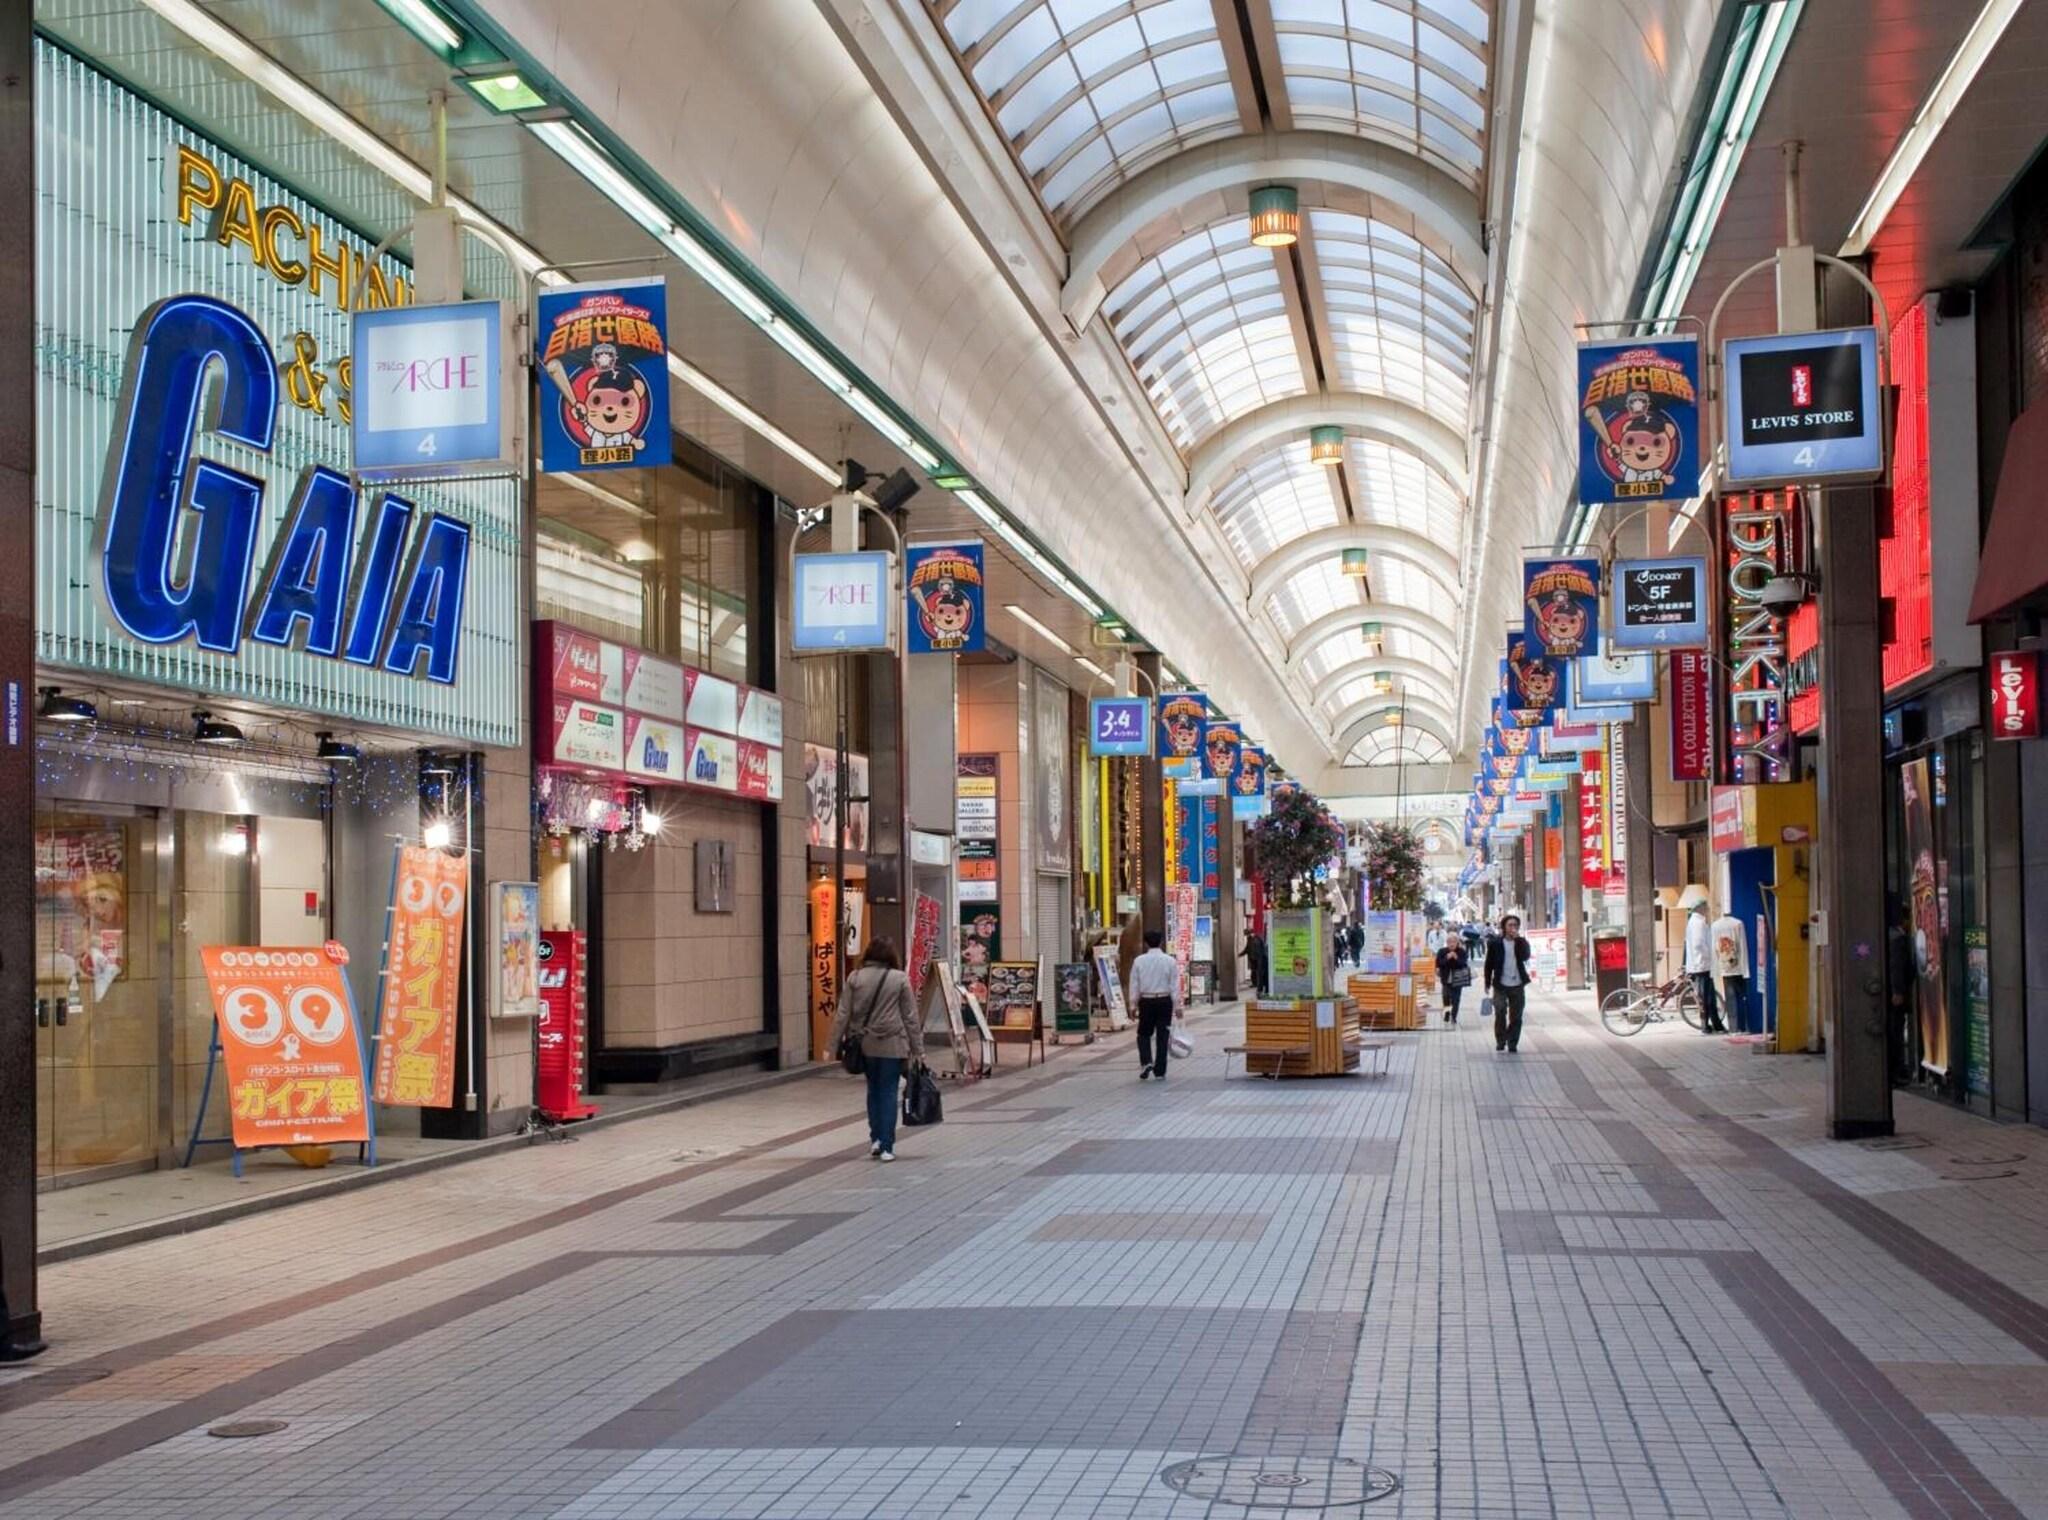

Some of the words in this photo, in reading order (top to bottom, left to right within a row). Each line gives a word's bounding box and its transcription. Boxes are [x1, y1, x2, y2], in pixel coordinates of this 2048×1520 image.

[177, 144, 416, 313] PACHIN
[543, 315, 665, 364] 目指せ優勝
[392, 354, 480, 395] ARCHE
[1583, 367, 1696, 409] 目指せ優勝
[1751, 415, 1799, 430] LEVI'S
[1804, 410, 1855, 425] STORE
[417, 432, 438, 457] 4
[1793, 446, 1815, 468] 4
[103, 294, 471, 686] GAIA
[817, 583, 874, 607] ARCHE
[1649, 585, 1671, 599] 5F
[833, 630, 846, 643] 4
[1655, 629, 1666, 640] 4
[1728, 511, 1784, 767] DONKEY
[1682, 676, 1697, 750] COLLECTION
[1683, 753, 1697, 769] LA
[814, 942, 835, 1017] ばりきや
[238, 993, 268, 1029] 3
[302, 994, 332, 1031] 9
[392, 918, 444, 1101] ガイア祭
[234, 1077, 361, 1118] ガイア祭
